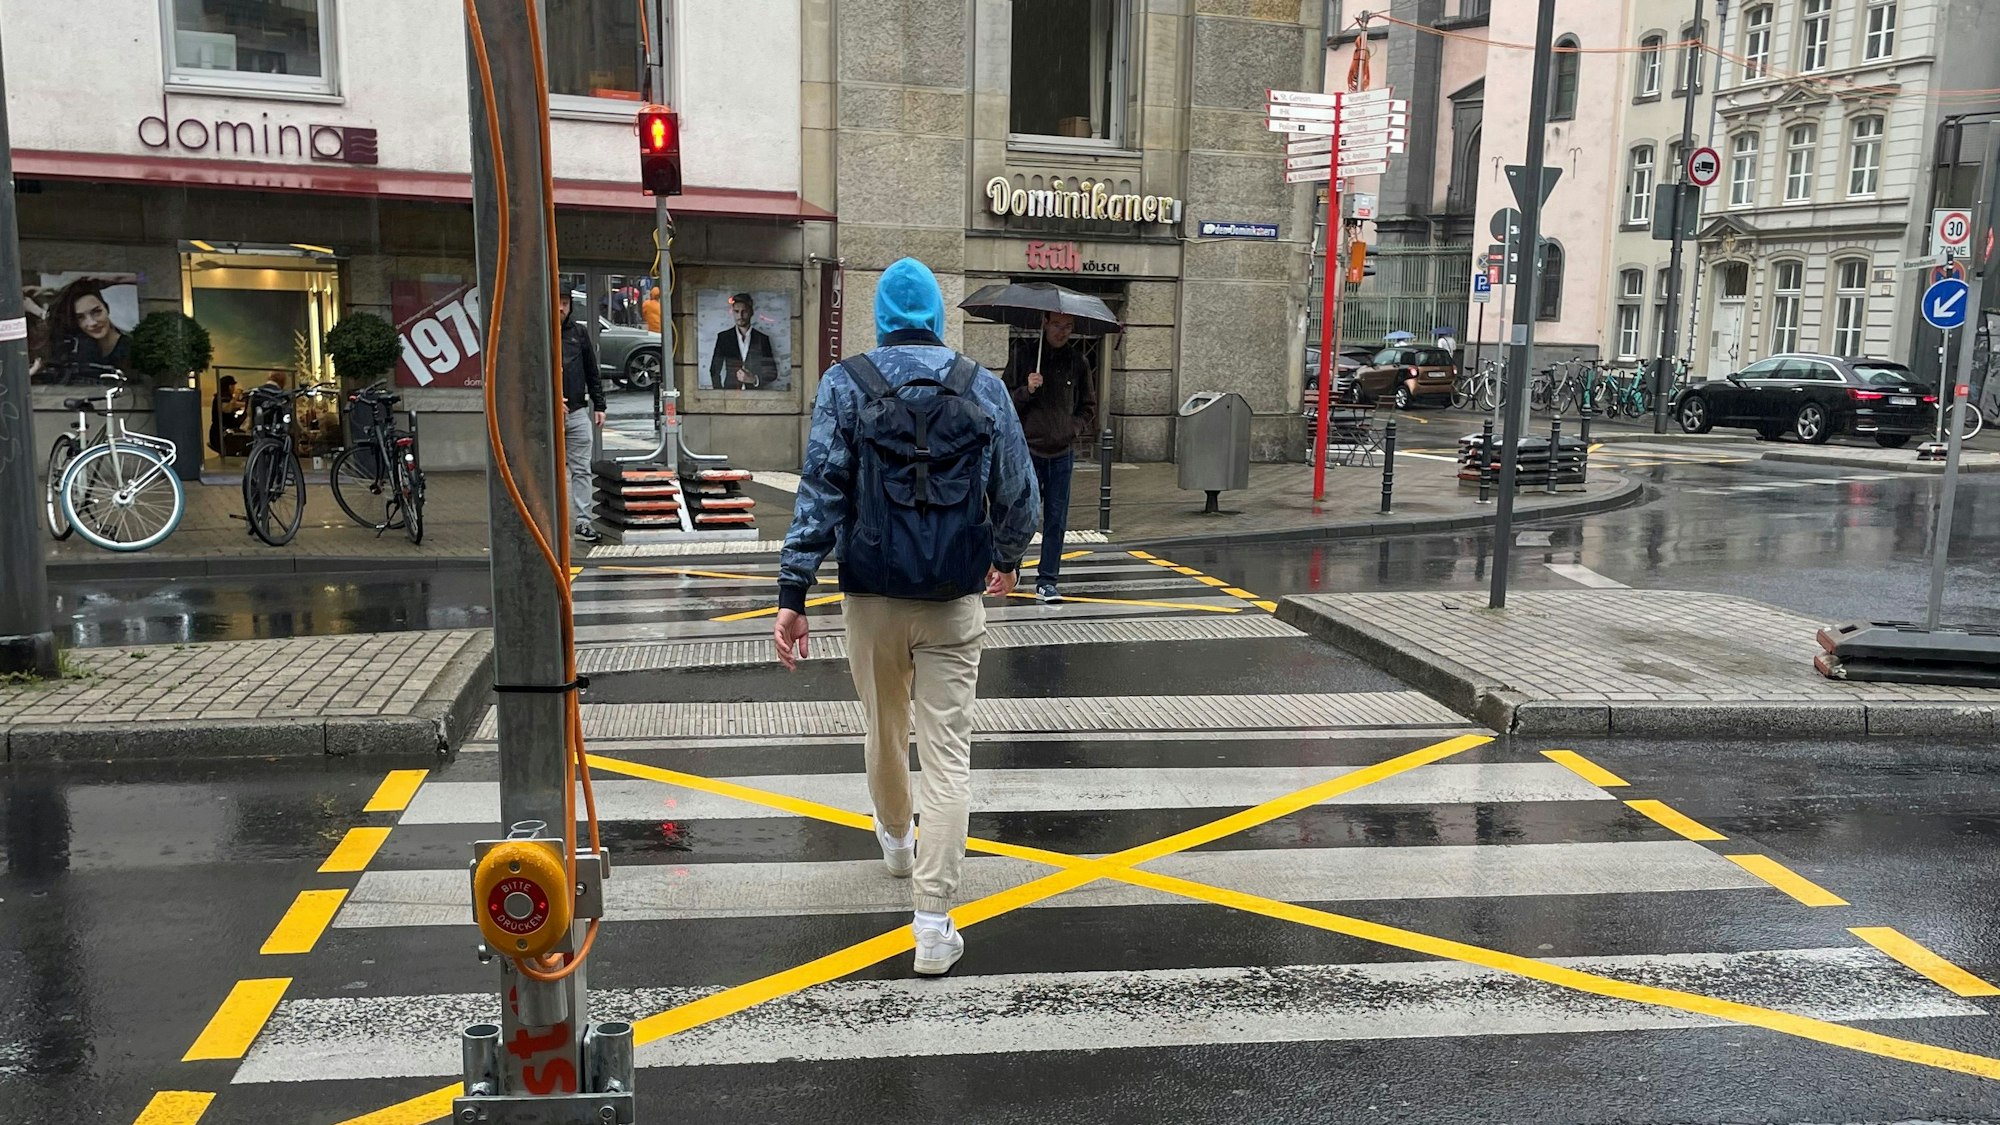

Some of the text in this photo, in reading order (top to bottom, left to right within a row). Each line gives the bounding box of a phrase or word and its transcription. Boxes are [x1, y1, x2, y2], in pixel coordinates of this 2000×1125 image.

[138, 94, 344, 160] domino
[986, 176, 1175, 224] Dominikaner
[1947, 221, 1963, 237] 30
[1082, 261, 1120, 272] KÖLSCH
[464, 377, 482, 387] dom
[501, 881, 531, 893] BITTE
